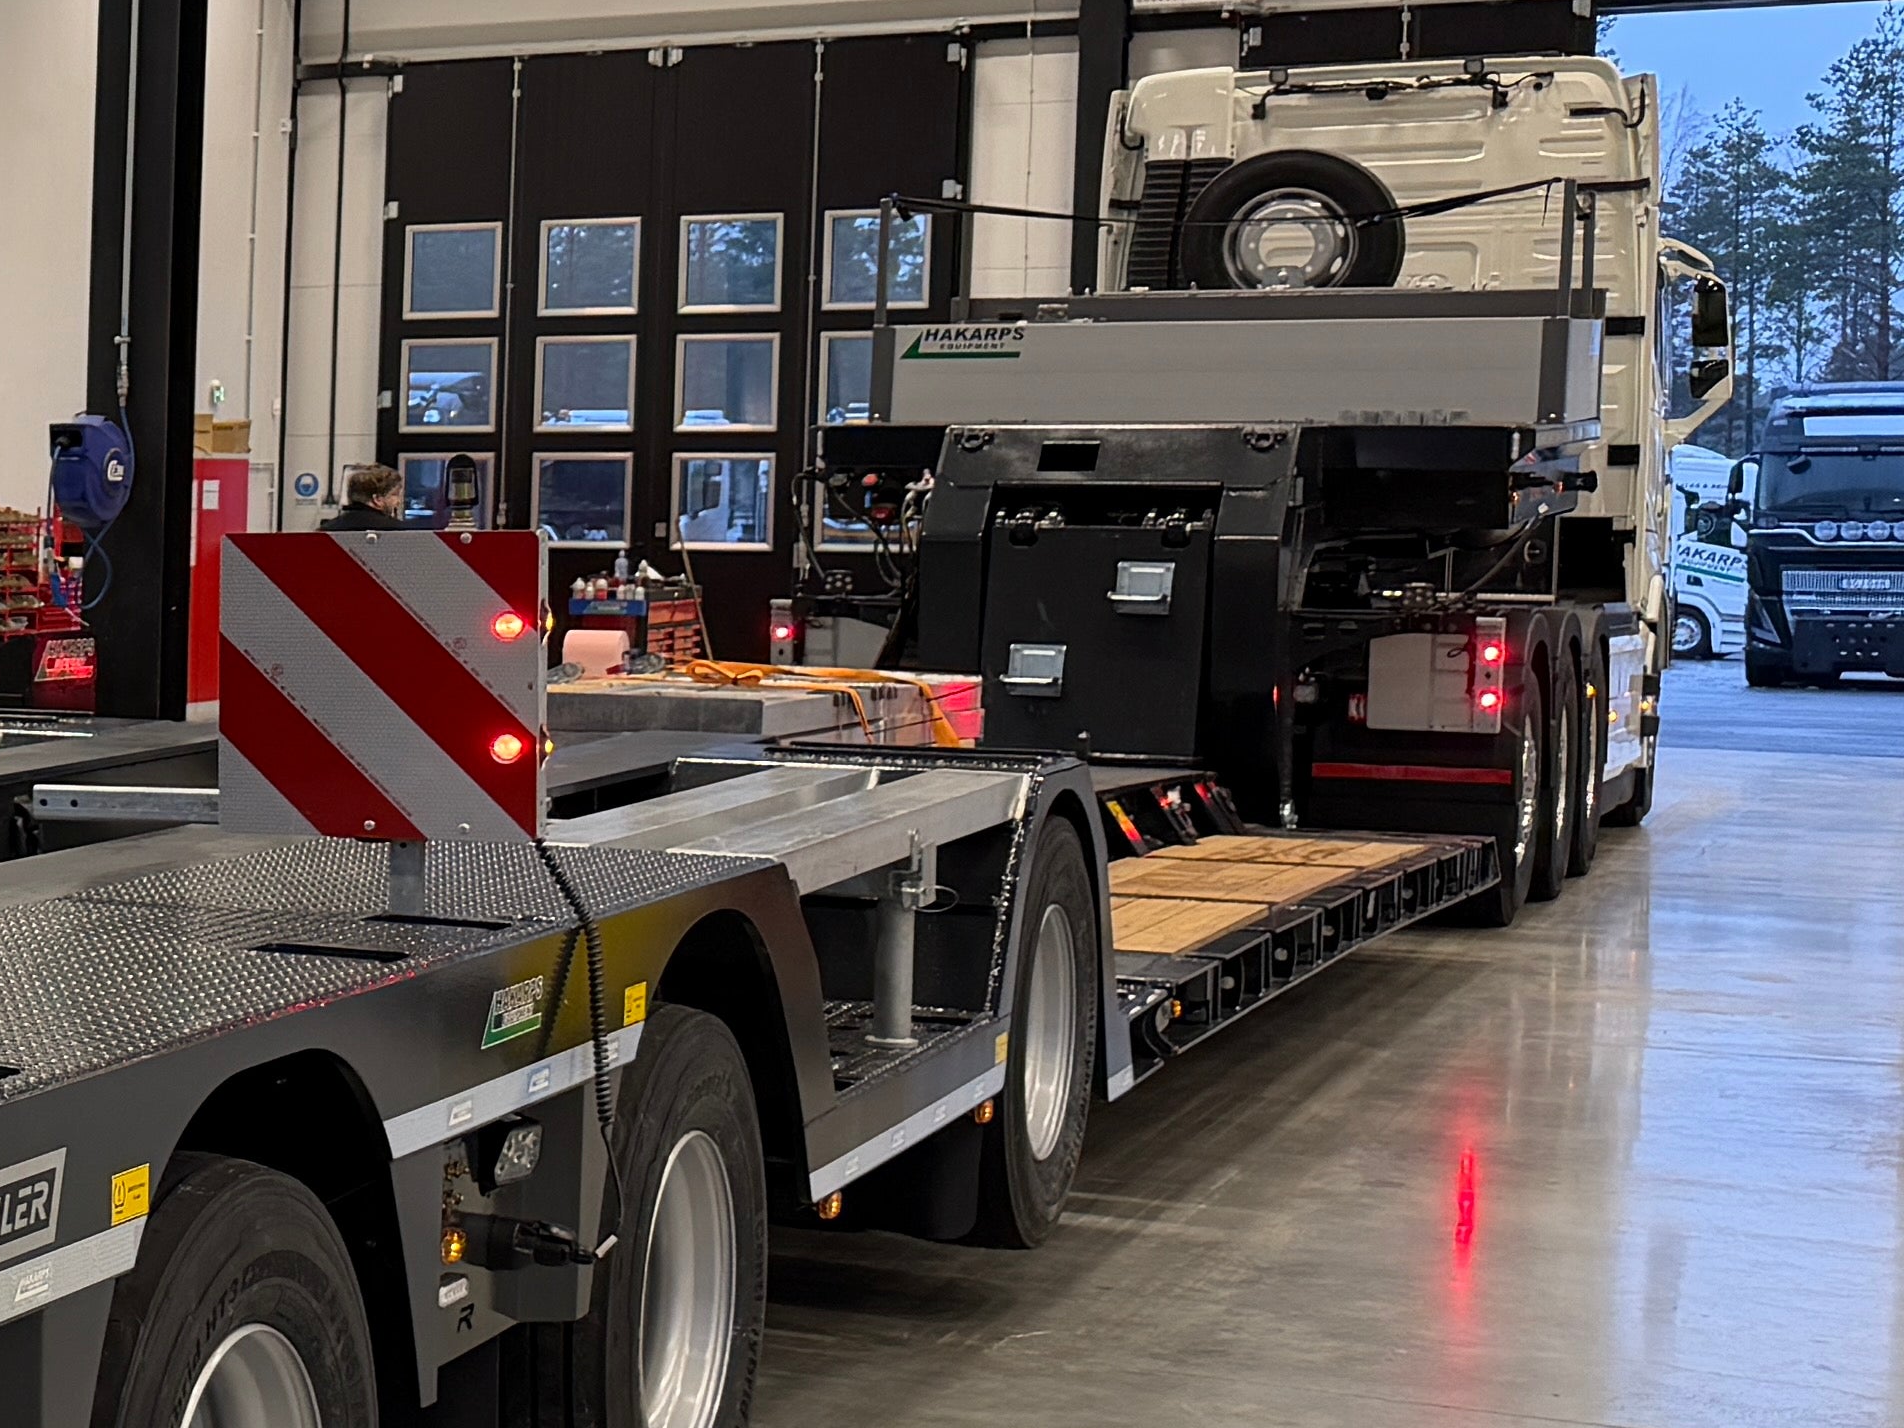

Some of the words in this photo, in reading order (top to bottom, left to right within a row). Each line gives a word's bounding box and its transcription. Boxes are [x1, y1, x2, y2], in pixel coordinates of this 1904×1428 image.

[923, 326, 1025, 342] HAKARPS
[939, 342, 1006, 350] EQUIPMENT
[494, 975, 544, 1013] HAKARPS
